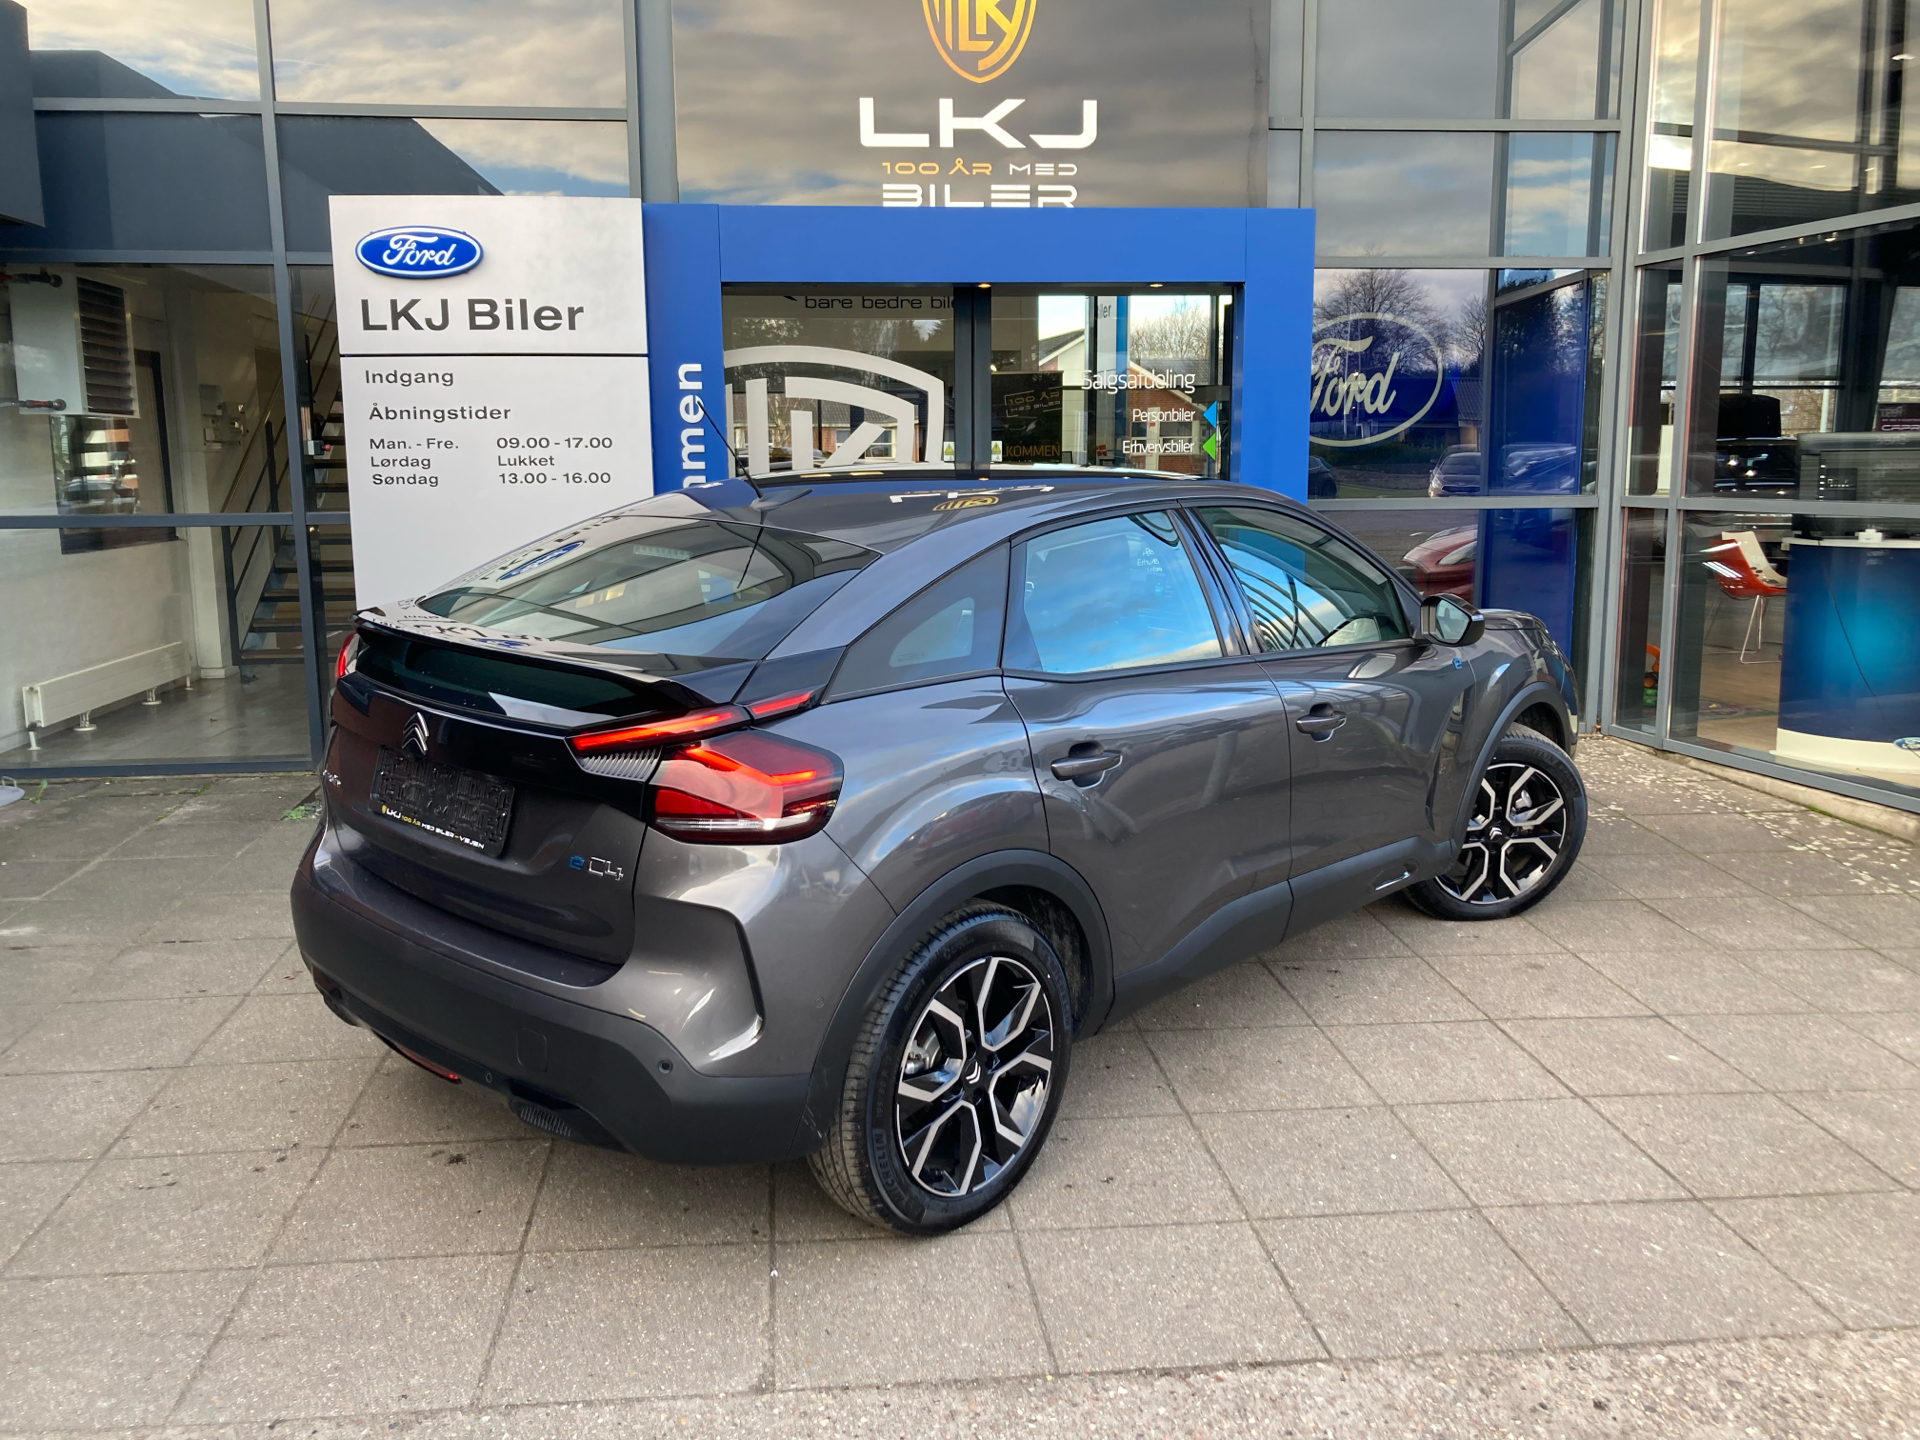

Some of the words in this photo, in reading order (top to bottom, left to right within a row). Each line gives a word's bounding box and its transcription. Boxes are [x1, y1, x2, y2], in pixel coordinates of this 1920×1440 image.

[859, 97, 1098, 149] LKJ
[882, 162, 939, 175] 100
[948, 157, 993, 175] ÅR
[1009, 163, 1078, 176] MED
[882, 183, 1078, 208] BILER
[382, 234, 457, 266] Ford
[804, 295, 853, 309] bare
[862, 295, 922, 309] bedre
[930, 295, 954, 309] bil
[360, 298, 450, 331] LKJ
[467, 298, 585, 331] Biler
[365, 369, 454, 387] Indgang
[1081, 368, 1196, 395] Salgsafdeling
[1310, 336, 1400, 416] Ford
[369, 403, 512, 423] Åbningstider
[1132, 408, 1195, 422] Personbiler
[369, 438, 412, 450] Man.
[426, 438, 459, 450] Fre.
[496, 437, 550, 449] 09.00
[564, 437, 613, 449] 17.00
[1123, 440, 1195, 454] Erhvervsbiler
[370, 456, 432, 470] Lørdag
[497, 455, 555, 467] Lukket
[372, 473, 439, 487] Søndag
[499, 472, 547, 484] 13.00
[563, 472, 611, 484] 16.00
[386, 808, 401, 819] LKJ
